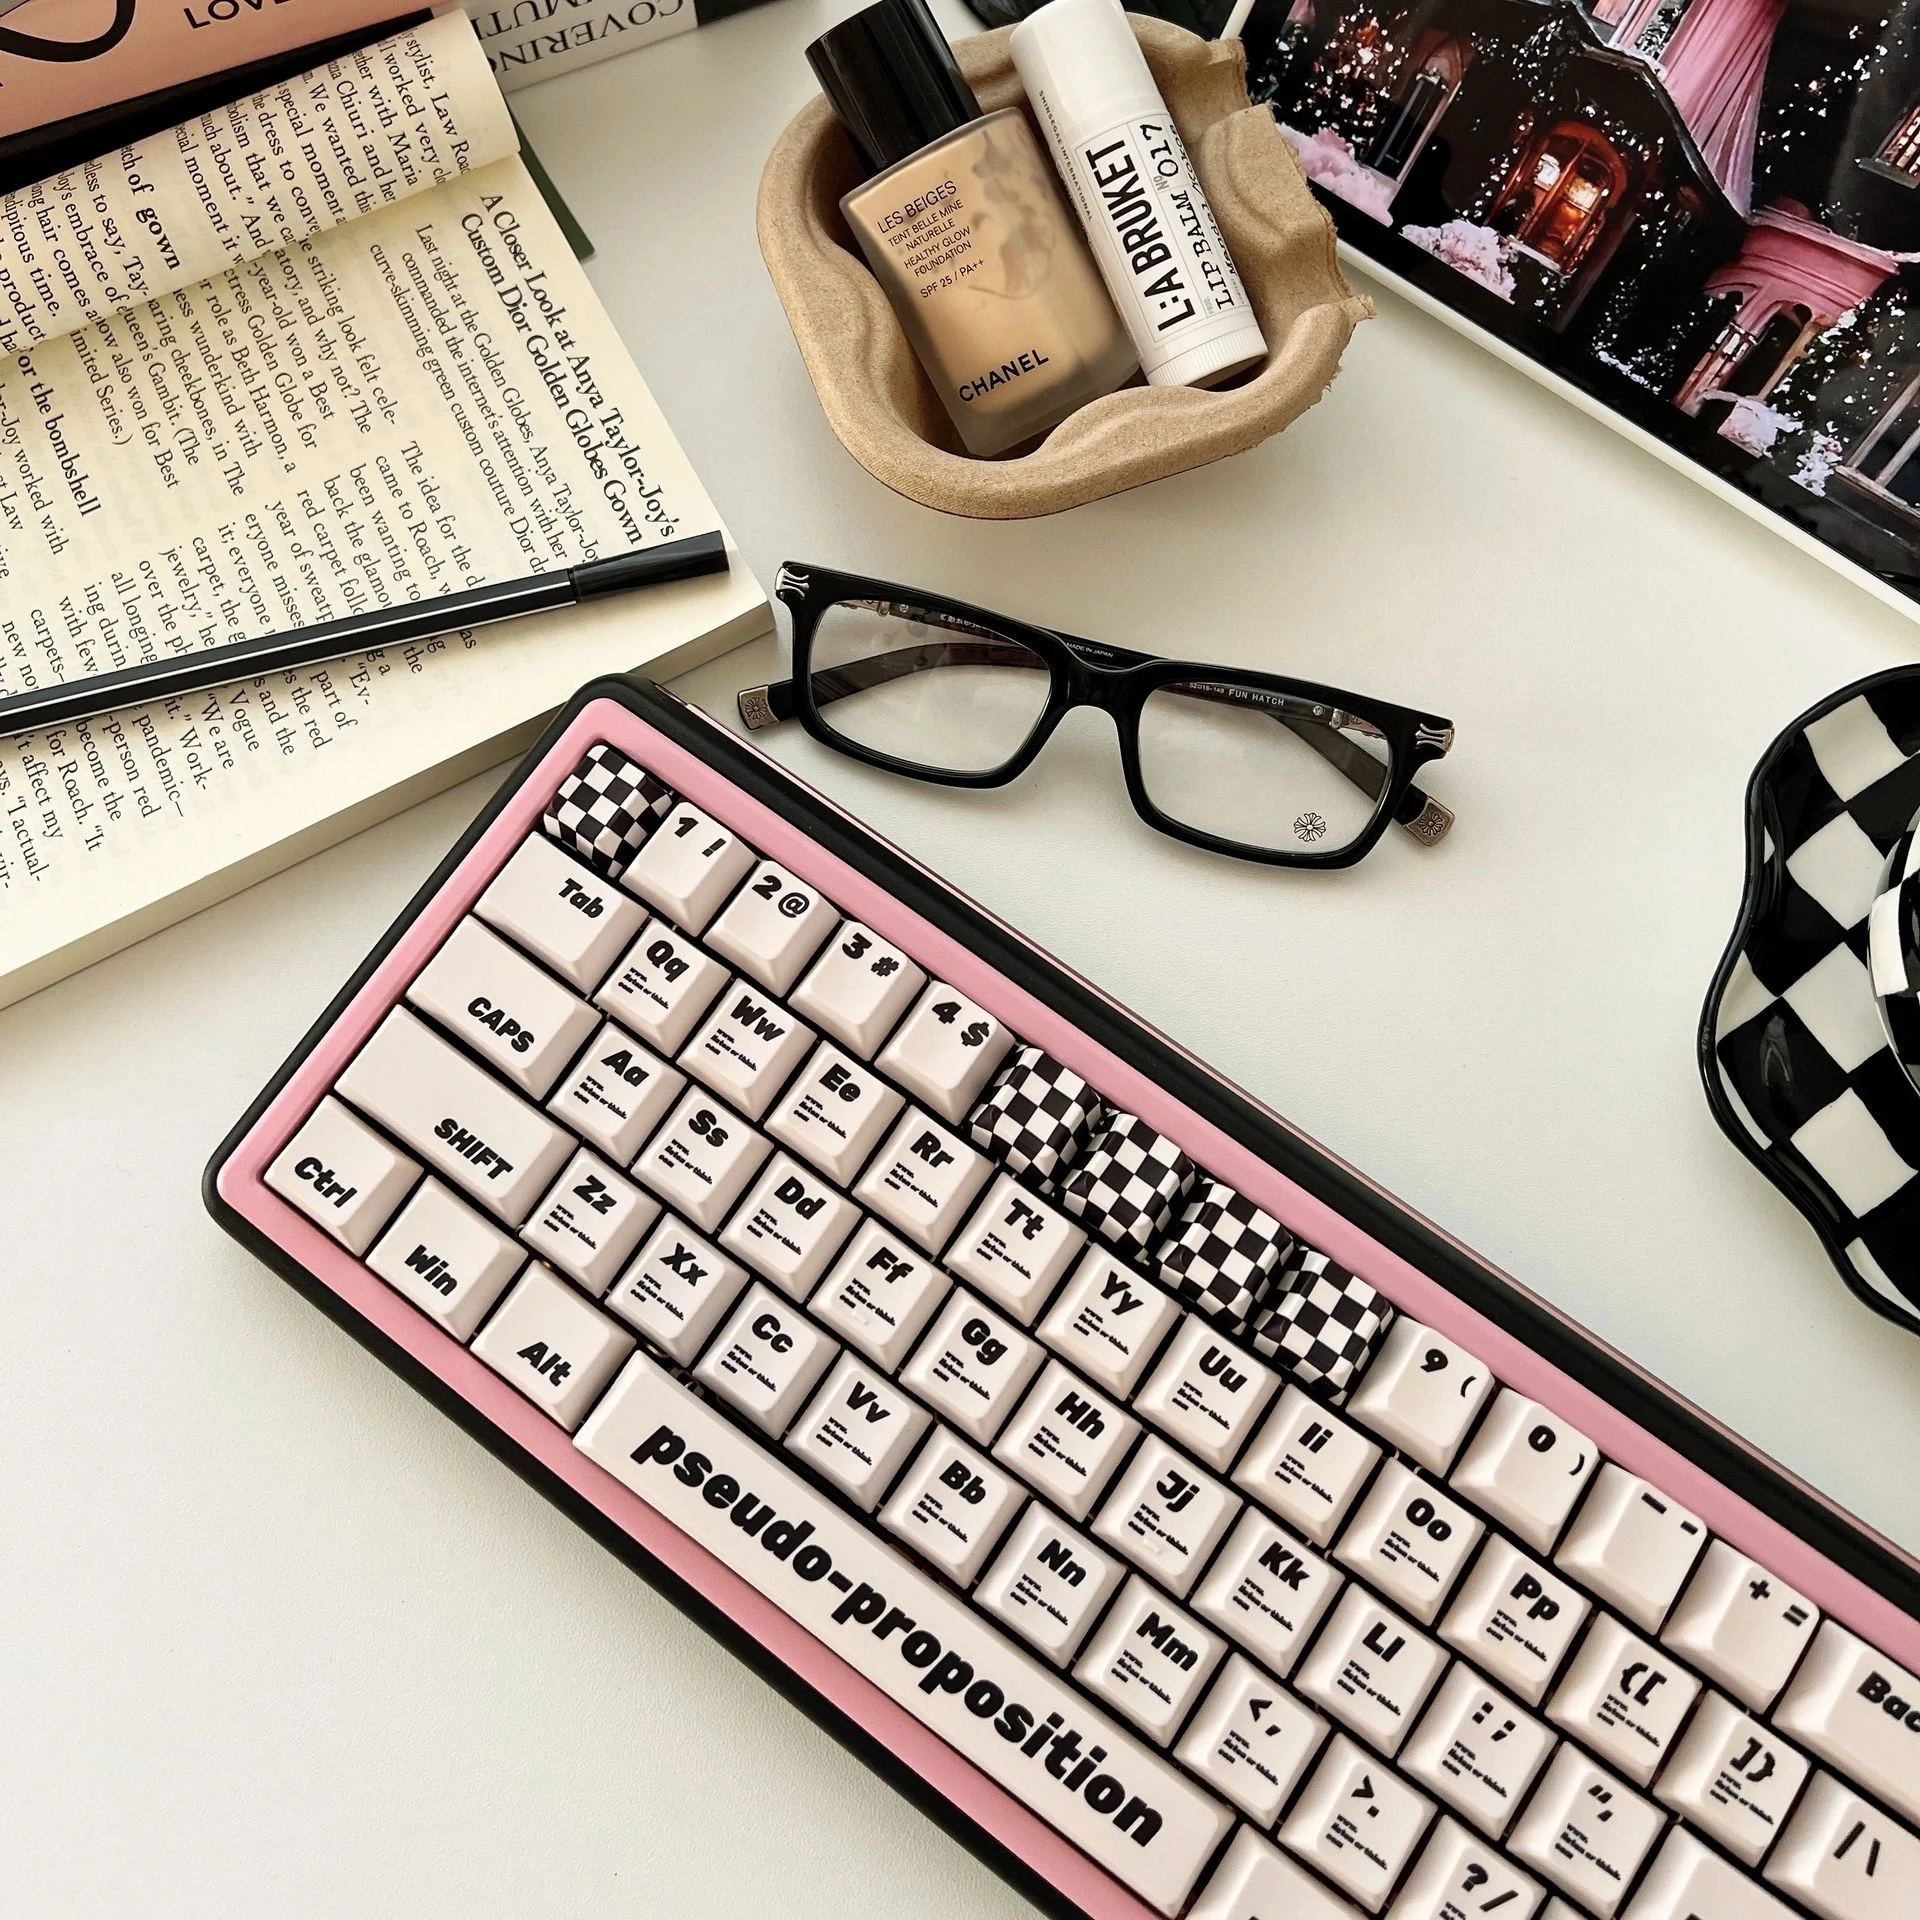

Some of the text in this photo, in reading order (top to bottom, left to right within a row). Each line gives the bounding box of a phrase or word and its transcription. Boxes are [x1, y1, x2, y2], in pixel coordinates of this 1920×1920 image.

[183, 0, 290, 30] LOV
[1138, 123, 1179, 178] 017
[876, 179, 957, 234] LES BEIGES
[1060, 145, 1093, 222] INTERNATIONAL
[127, 173, 181, 271] of gown
[887, 198, 964, 247] TEINT BELLE MINE
[904, 217, 956, 252] NATURELLE
[1084, 139, 1196, 332] L:A BRUKET
[903, 225, 971, 270] HEALTHY GLOW
[913, 239, 972, 278] FOUNDATION
[1169, 189, 1235, 311] LIP BALM
[919, 281, 938, 299] SPF
[939, 274, 953, 289] 25
[958, 259, 984, 277] PA++
[306, 255, 398, 425] striking look felt cele-
[415, 223, 439, 255] Last
[430, 255, 459, 292] night
[450, 292, 467, 308] at
[459, 308, 479, 333] the
[473, 332, 507, 389] Golden
[501, 386, 534, 444] Globes,
[528, 446, 557, 486] Anya
[189, 319, 263, 459] wunderkind with
[247, 314, 317, 448] Golden Globe for
[297, 297, 373, 434] and why not? The
[460, 212, 643, 545] Custom Dior Golden Globes Gown
[479, 195, 680, 538] A Closer Look at Anya Taylor-Joy's
[954, 348, 1050, 409] CHANEL
[170, 348, 246, 496] cheekbones, in The
[369, 243, 536, 553] curve-skimming green custom couture Dior
[401, 251, 568, 558] commanded the internet's attention with her
[29, 381, 102, 517] the bombshell
[375, 455, 446, 580] came to Roach,
[400, 439, 472, 572] The idea for the
[349, 462, 421, 602] been wanting to
[1092, 649, 1114, 658] JAPAN
[1228, 687, 1249, 699] FUN
[1251, 692, 1286, 706] HATCH
[21, 753, 63, 838] affect my
[43, 728, 95, 825] for Roach.
[673, 816, 727, 858] 1 !
[557, 877, 605, 919] Tab
[645, 939, 690, 984] Qq
[841, 931, 900, 978] 3 #
[467, 996, 535, 1053] CAPS
[729, 994, 786, 1042] Ww
[931, 1000, 990, 1047] 4 $
[599, 1048, 650, 1088] Aa
[818, 1062, 861, 1103] Ee
[433, 1117, 514, 1180] SHIFT
[687, 1108, 729, 1148] Ss
[909, 1129, 955, 1169] Rr
[293, 1156, 358, 1209] Ctrl
[572, 1174, 618, 1215] Zz
[773, 1175, 827, 1221] Dd
[1003, 1197, 1045, 1241] Tt
[403, 1243, 458, 1297] Win
[658, 1241, 709, 1287] Xx
[865, 1246, 915, 1284] Ff
[1099, 1269, 1144, 1316] Yy
[751, 1313, 794, 1354] Cc
[960, 1317, 1009, 1366] Gg
[515, 1341, 572, 1387] Alt
[1198, 1345, 1248, 1394] Uu
[1419, 1348, 1449, 1373] 9
[845, 1380, 891, 1424] Vv
[1054, 1390, 1105, 1440] Hh
[1297, 1421, 1334, 1454] Ii
[938, 1458, 987, 1505] Bb
[1155, 1469, 1201, 1513] Jj
[1405, 1497, 1452, 1542] Oo
[1036, 1538, 1087, 1588] Nn
[1257, 1540, 1310, 1592] Kk
[1509, 1572, 1560, 1621] Pp
[629, 1424, 1163, 1848] pseudo-proposition
[1135, 1611, 1198, 1672] Mm
[1461, 1862, 1489, 1893] ?
